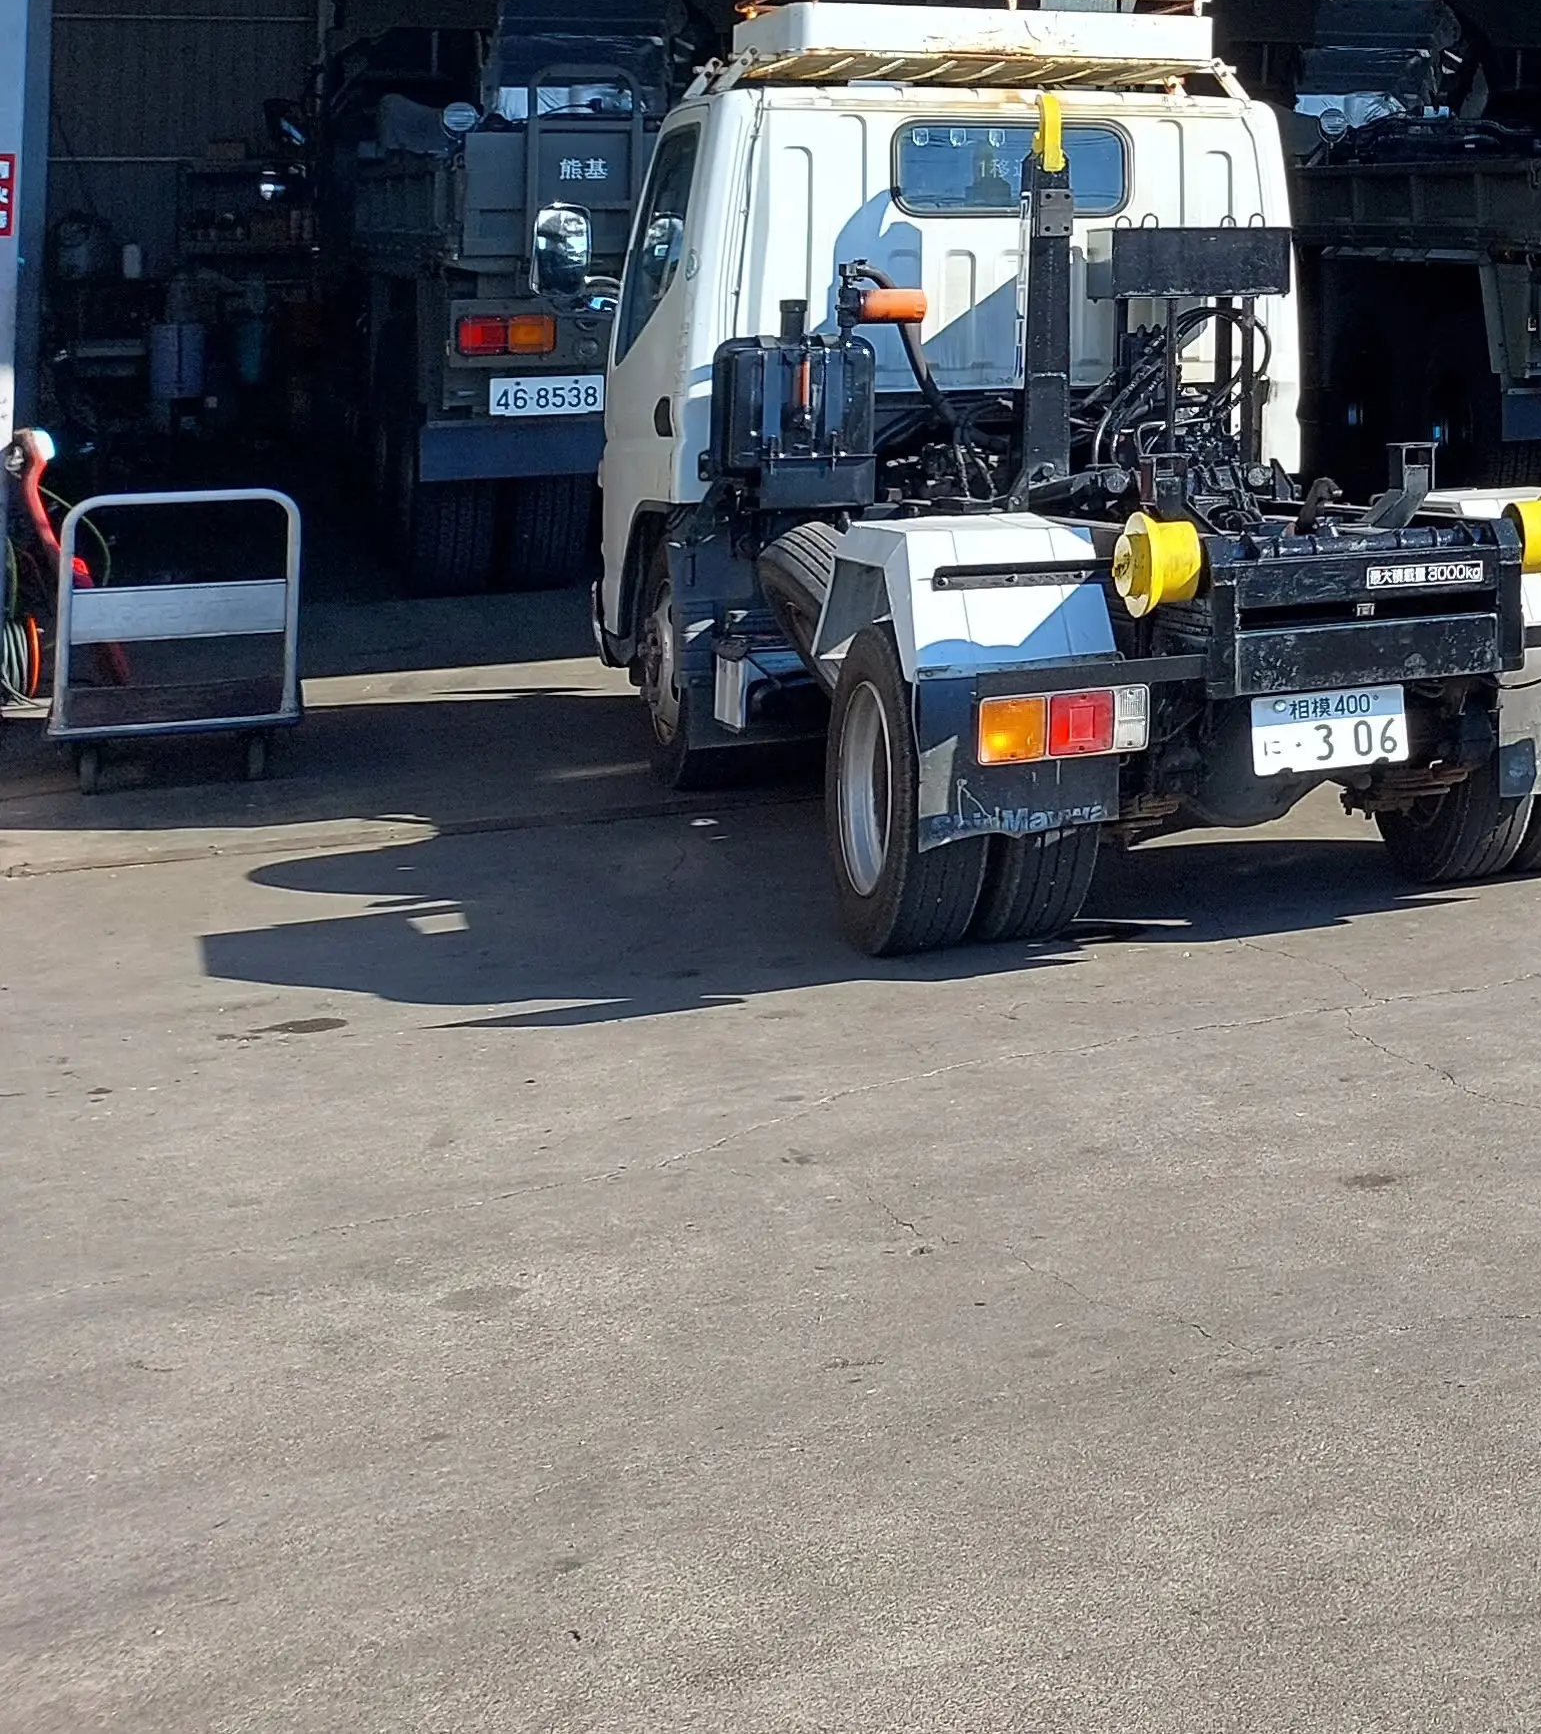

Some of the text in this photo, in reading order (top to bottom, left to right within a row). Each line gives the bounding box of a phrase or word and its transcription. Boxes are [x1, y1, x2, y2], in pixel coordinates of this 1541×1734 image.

[559, 158, 608, 180] 熊基
[496, 385, 599, 411] 46-8538
[1289, 694, 1371, 720] 相模400
